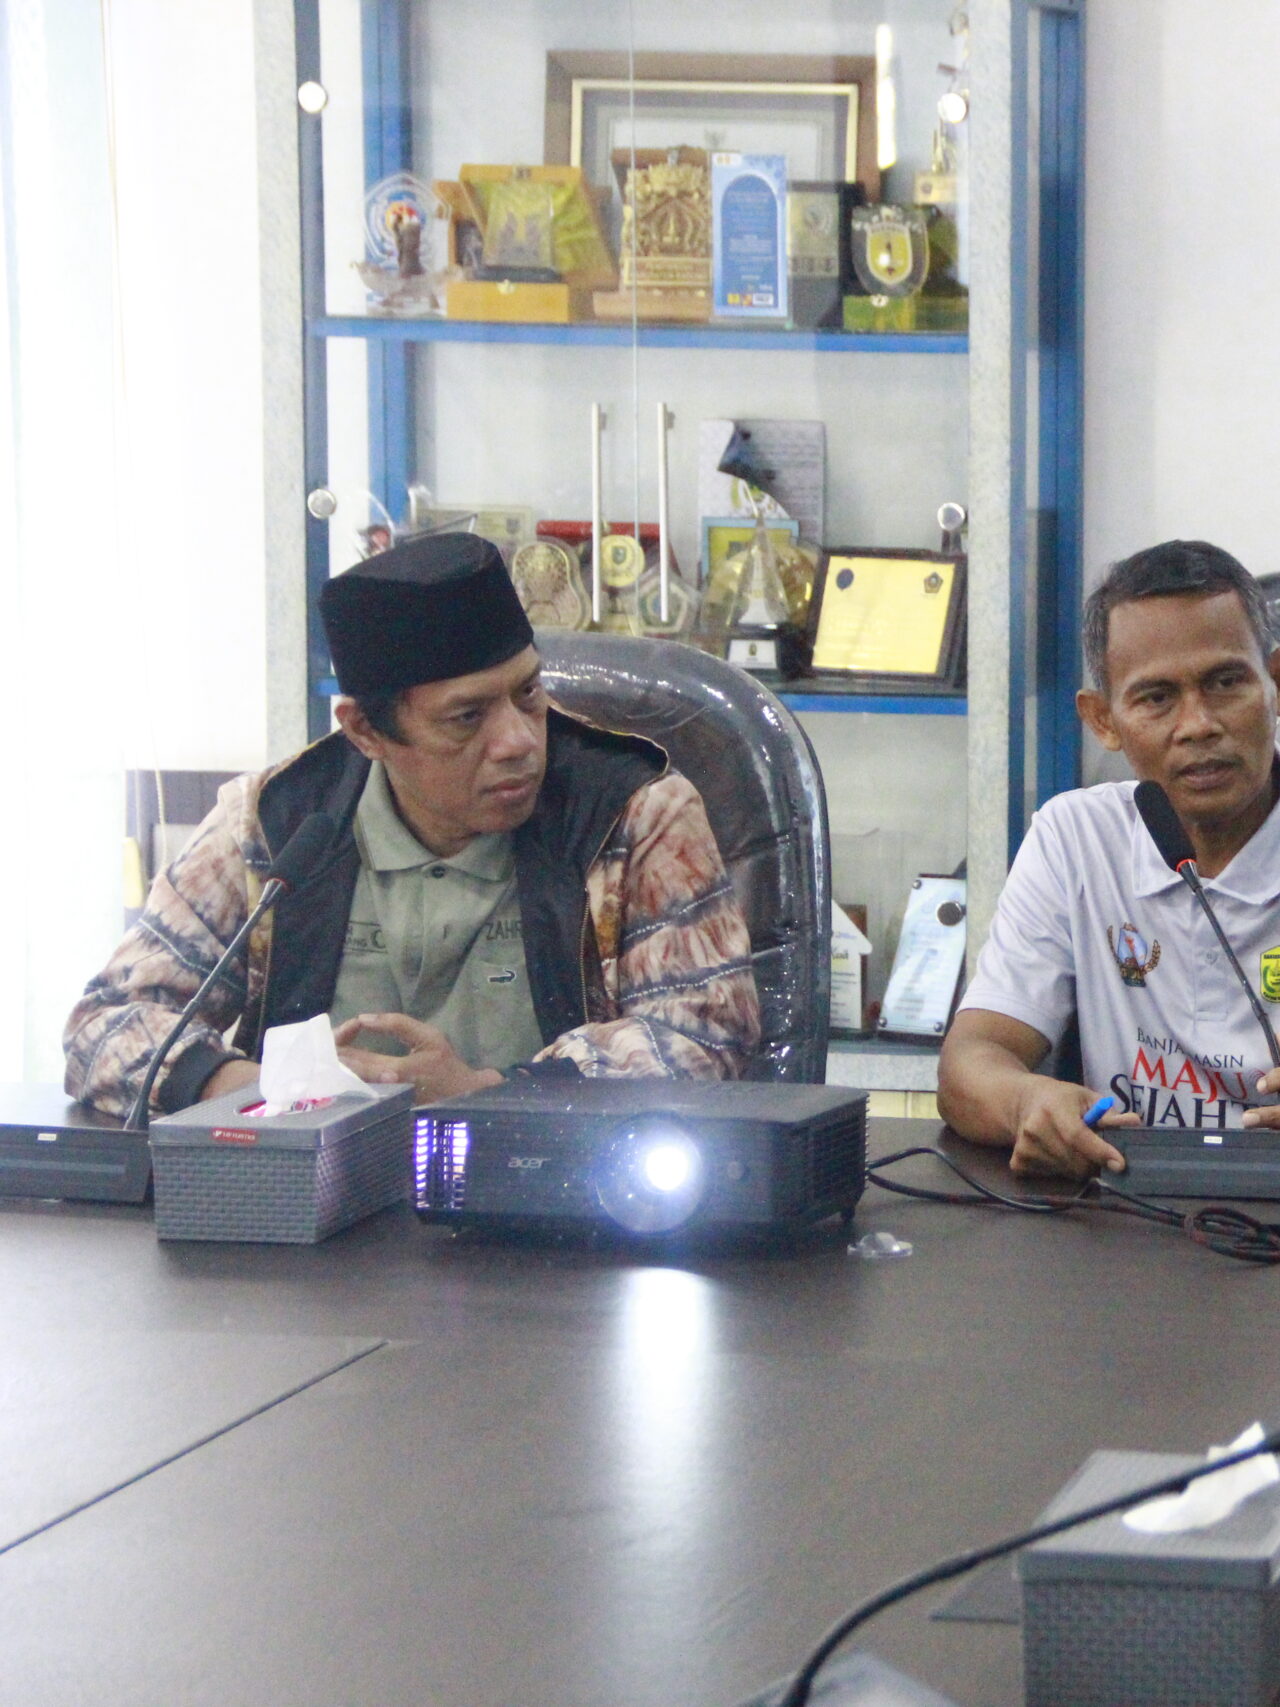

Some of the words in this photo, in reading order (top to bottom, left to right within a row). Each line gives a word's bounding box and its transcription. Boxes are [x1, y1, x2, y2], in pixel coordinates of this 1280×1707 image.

[1137, 1026, 1244, 1069] BANJAMASIN
[1132, 1046, 1248, 1104] MAJU
[508, 1157, 551, 1169] acer
